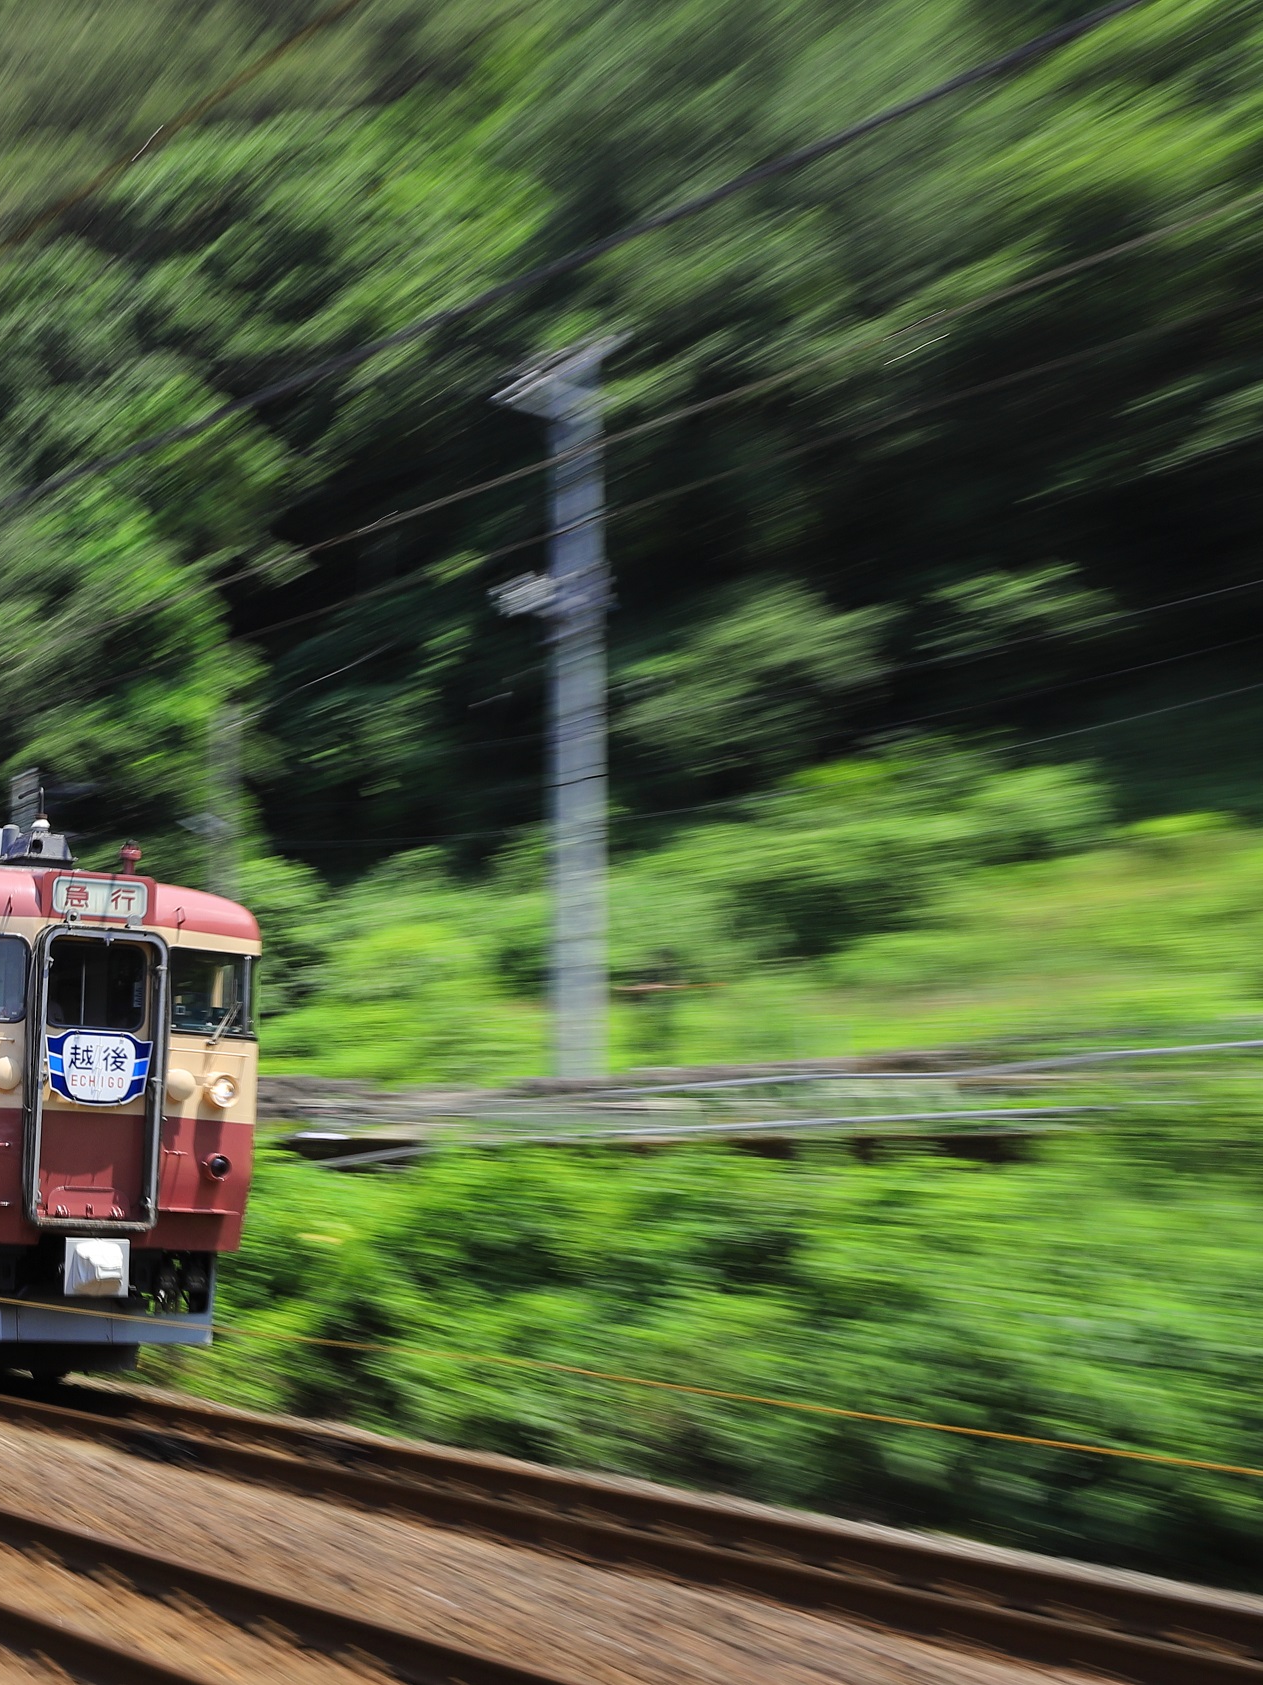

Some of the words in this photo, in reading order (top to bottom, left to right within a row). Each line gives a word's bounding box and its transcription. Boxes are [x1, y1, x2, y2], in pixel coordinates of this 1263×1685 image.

[65, 884, 135, 911] 急行
[68, 1044, 128, 1072] 越後
[71, 1074, 124, 1089] ECHIGO
